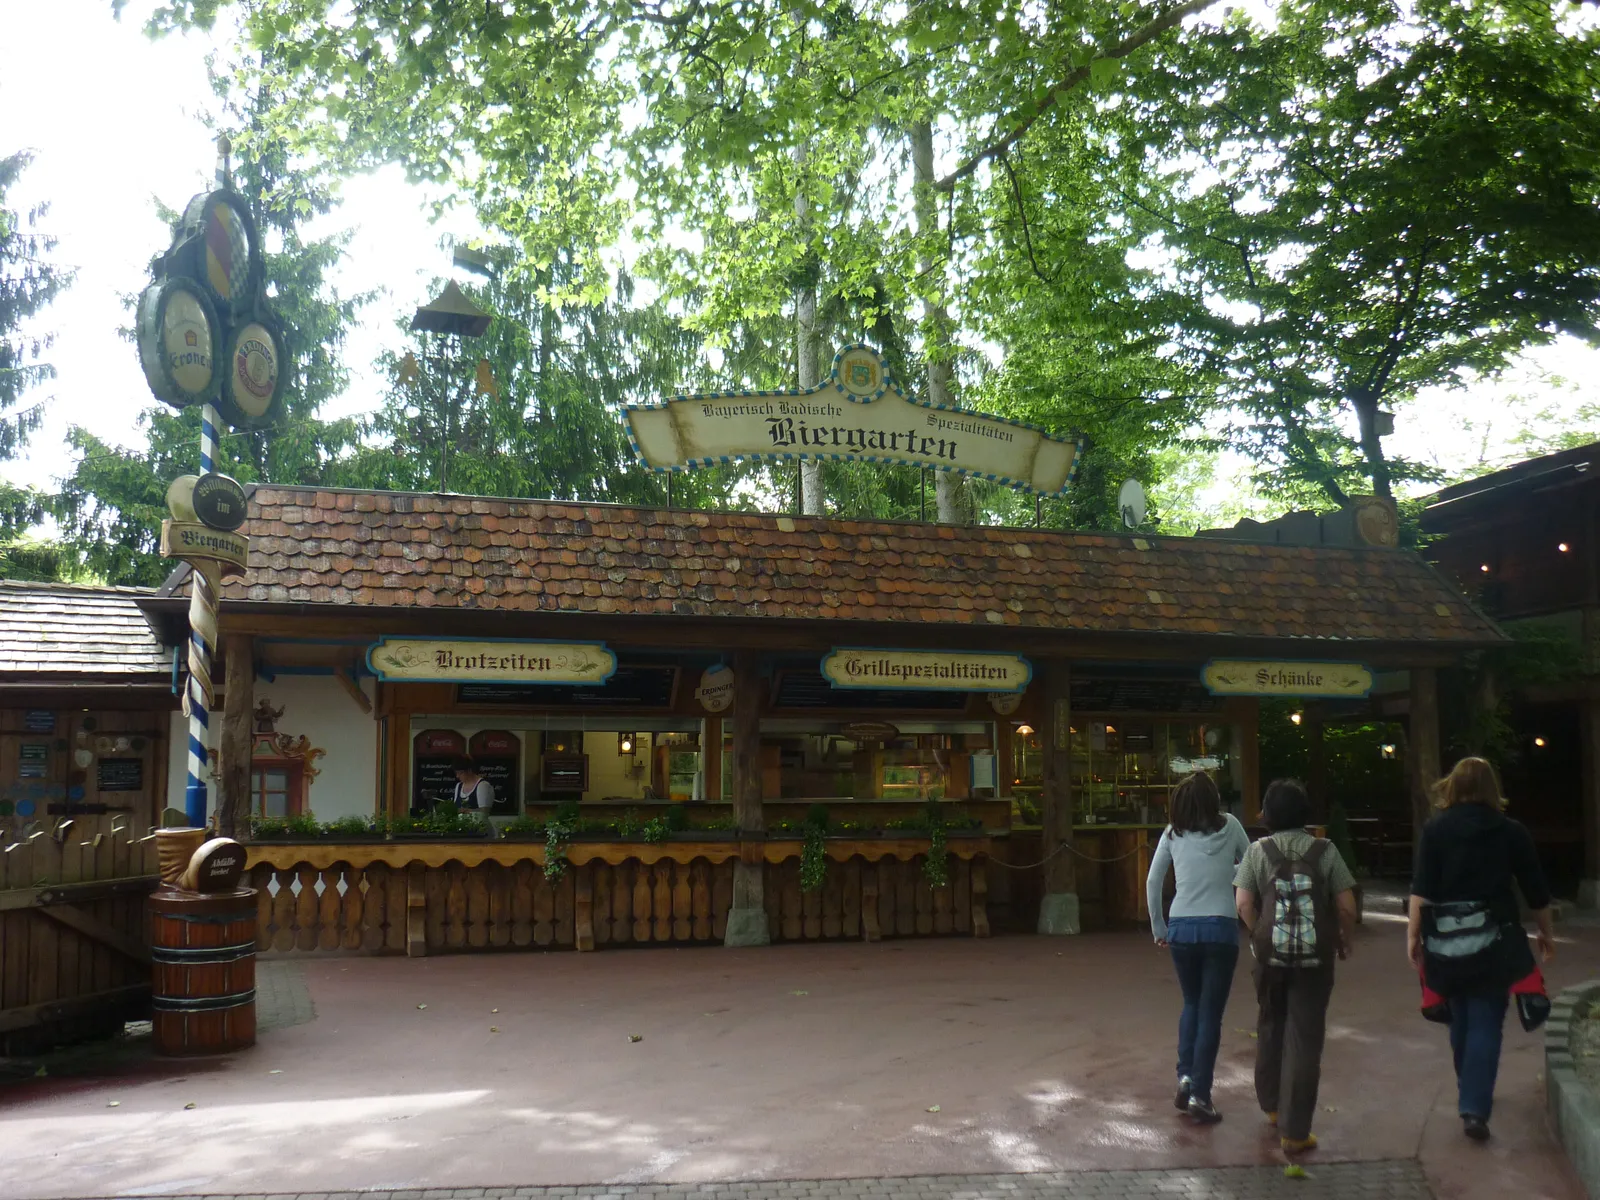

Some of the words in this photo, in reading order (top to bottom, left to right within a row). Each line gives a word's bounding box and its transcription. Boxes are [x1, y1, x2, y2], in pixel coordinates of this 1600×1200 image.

[702, 402, 774, 420] Bayerisch
[778, 401, 843, 418] Badische
[764, 416, 958, 461] Biergarten
[925, 412, 1014, 443] Spezialitäten
[216, 498, 231, 514] im
[180, 530, 245, 557] Biergarten
[435, 649, 551, 672] Brotzeiten
[845, 658, 1008, 681] Grillspezialitäten
[701, 682, 734, 696] ERDINGER
[1254, 667, 1323, 689] Schänke
